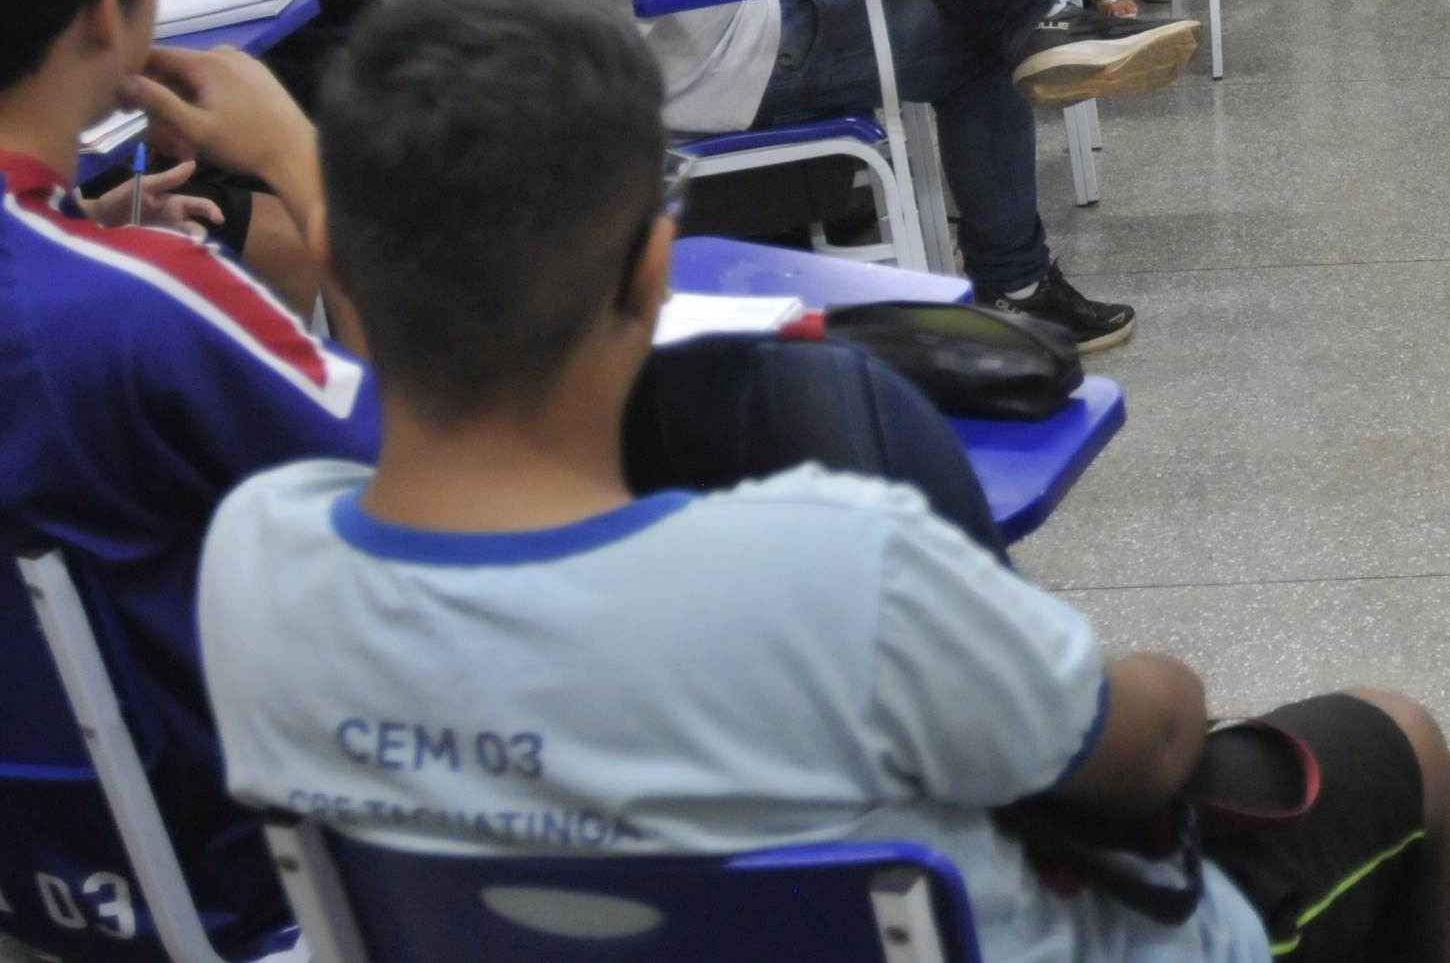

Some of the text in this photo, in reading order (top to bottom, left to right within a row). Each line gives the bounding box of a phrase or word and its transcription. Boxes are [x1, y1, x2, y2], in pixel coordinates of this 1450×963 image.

[337, 718, 545, 780] CEM 03
[36, 870, 136, 940] 03
